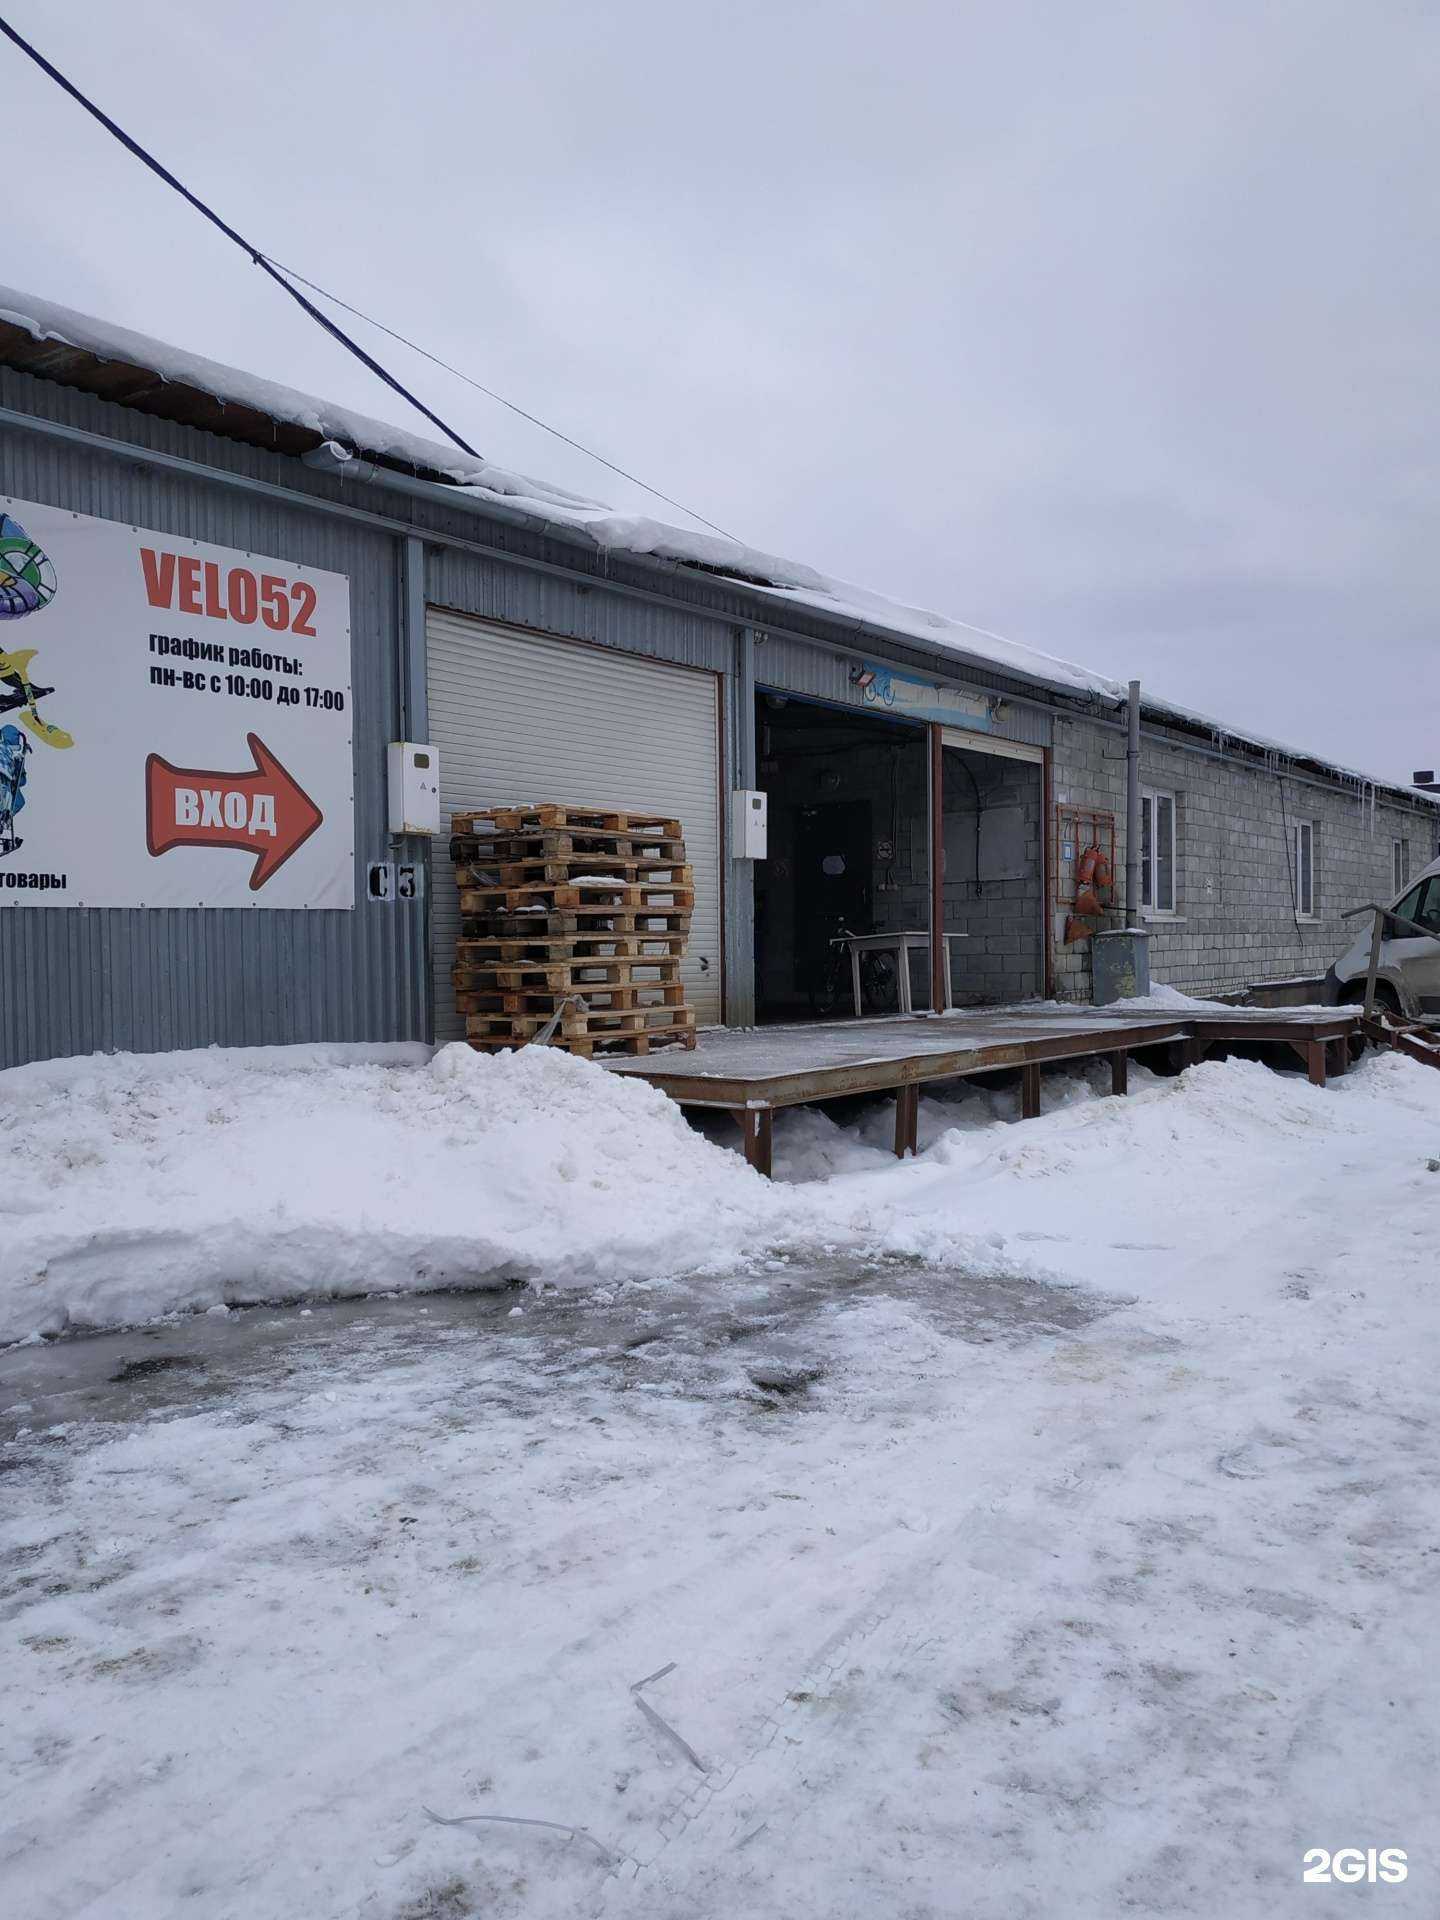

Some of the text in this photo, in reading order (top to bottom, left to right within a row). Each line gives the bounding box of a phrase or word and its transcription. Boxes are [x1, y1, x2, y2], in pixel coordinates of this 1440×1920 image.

[140, 548, 317, 637] VELO52
[149, 633, 303, 676] график работы:
[210, 675, 221, 693] с
[225, 674, 273, 701] 10:00
[276, 685, 301, 706] до
[304, 687, 345, 712] 17:00
[174, 787, 278, 837] ВХОД
